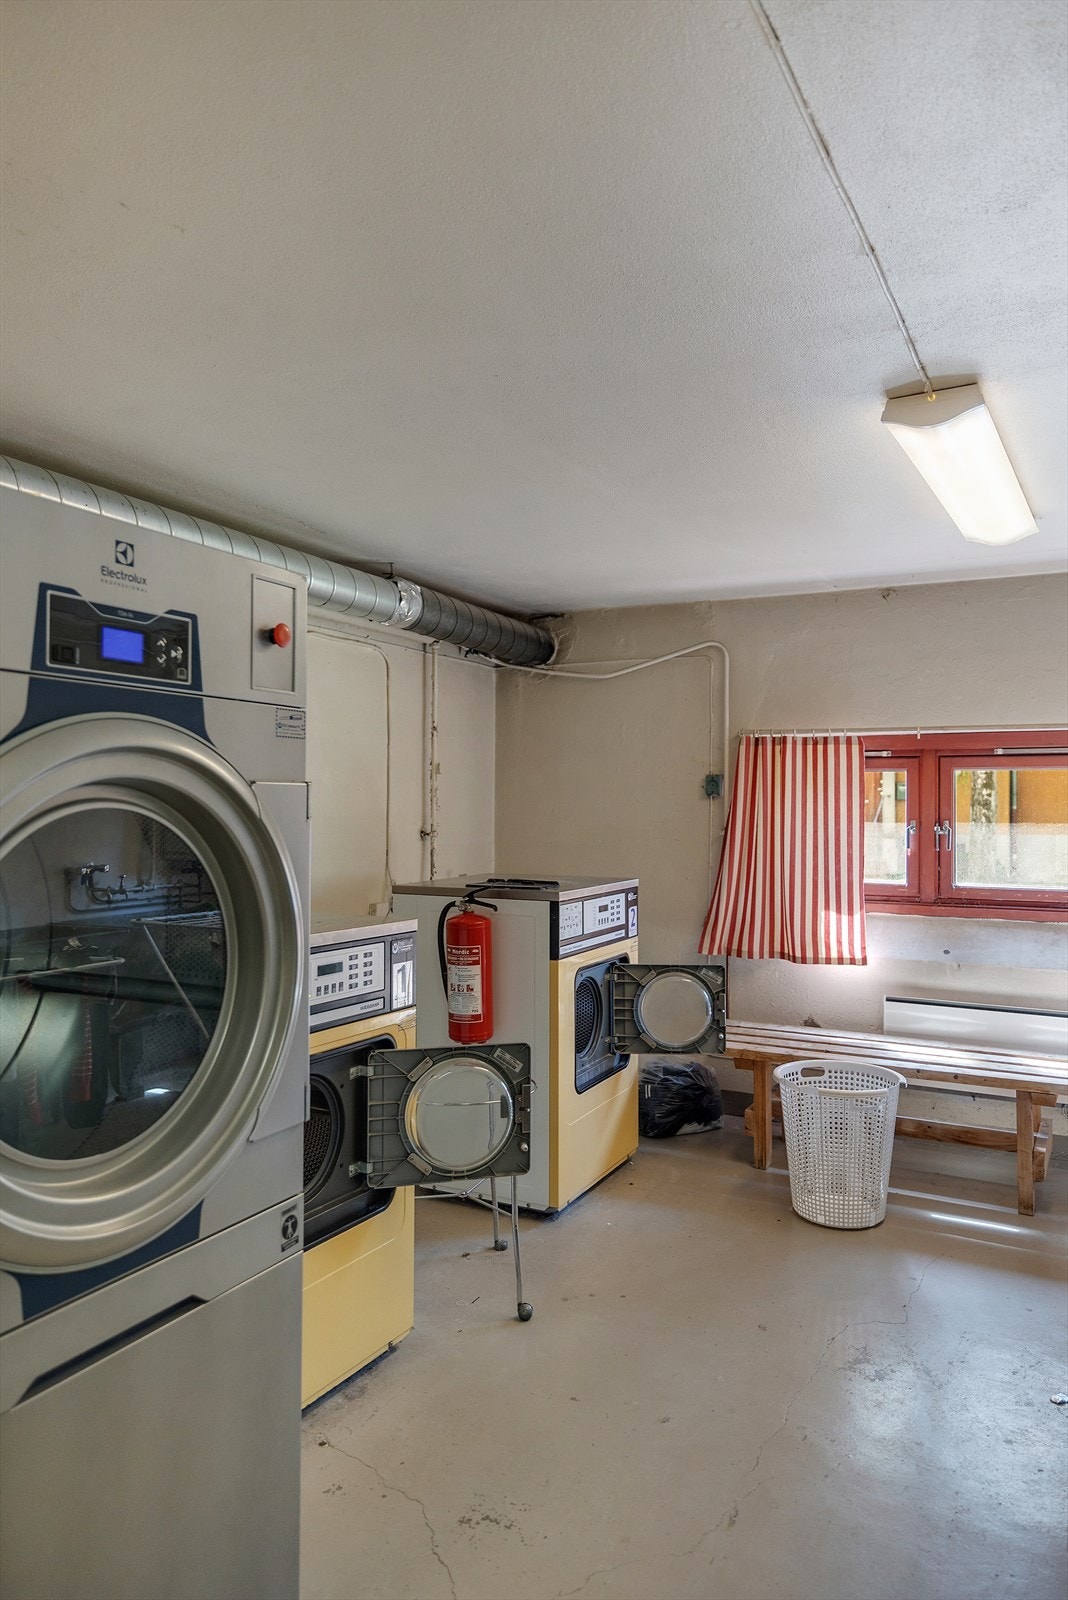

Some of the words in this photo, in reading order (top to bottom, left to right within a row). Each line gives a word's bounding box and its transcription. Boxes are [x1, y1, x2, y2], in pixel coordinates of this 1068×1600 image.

[101, 565, 147, 584] Electrolux
[630, 908, 635, 927] 2
[397, 964, 406, 993] 1
